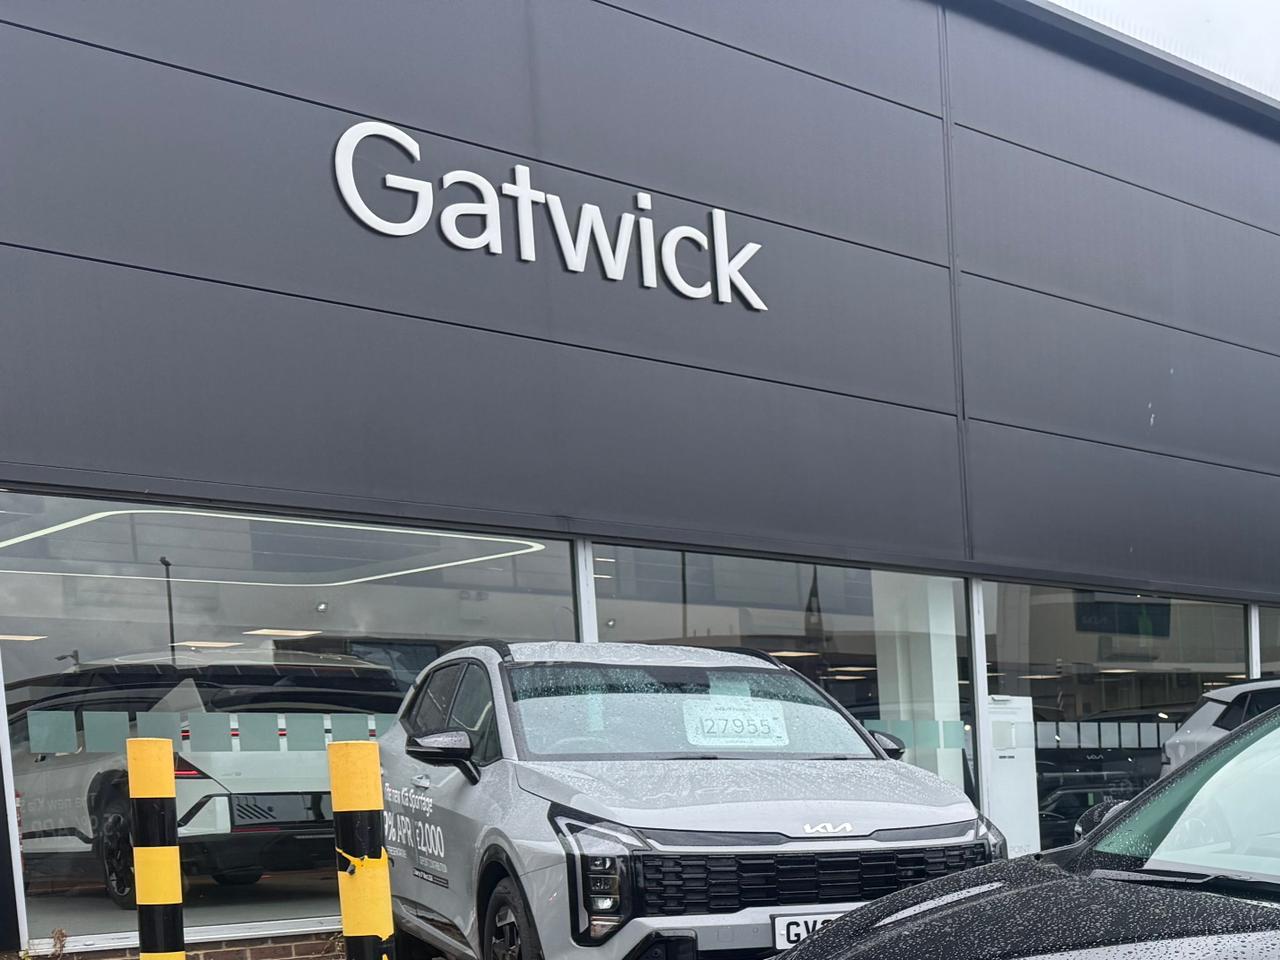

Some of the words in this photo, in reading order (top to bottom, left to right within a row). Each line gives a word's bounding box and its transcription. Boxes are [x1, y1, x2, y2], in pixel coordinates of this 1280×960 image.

[334, 121, 768, 311] Gatwick
[409, 788, 433, 817] Sportage
[396, 814, 415, 848] APR
[803, 822, 853, 833] KIA
[786, 919, 832, 944] GV
